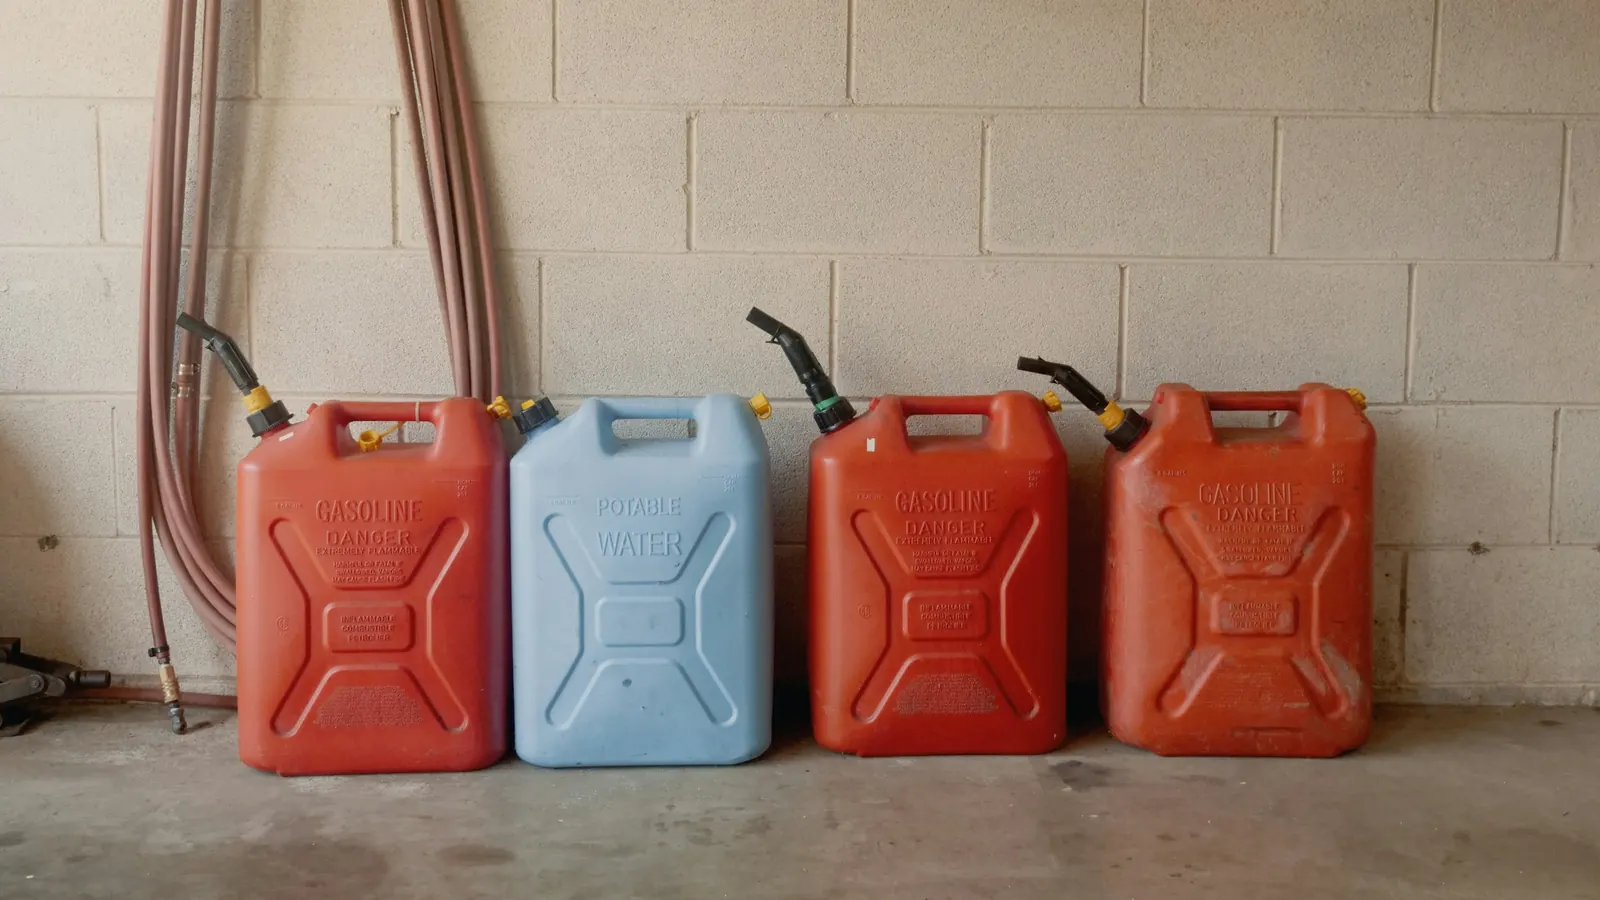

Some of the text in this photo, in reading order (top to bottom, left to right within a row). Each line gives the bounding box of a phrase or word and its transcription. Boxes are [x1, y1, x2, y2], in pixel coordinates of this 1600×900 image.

[895, 489, 997, 514] GASOLINE
[1199, 482, 1304, 506] GASOLINE
[315, 499, 422, 522] GASOLINE
[596, 497, 681, 516] POTABLE
[1217, 507, 1298, 522] DANGER
[905, 519, 986, 536] DANGER
[326, 529, 413, 546] DANGER
[596, 531, 682, 556] WATER
[315, 547, 421, 556] EXTREMELY FLAMMABLE
